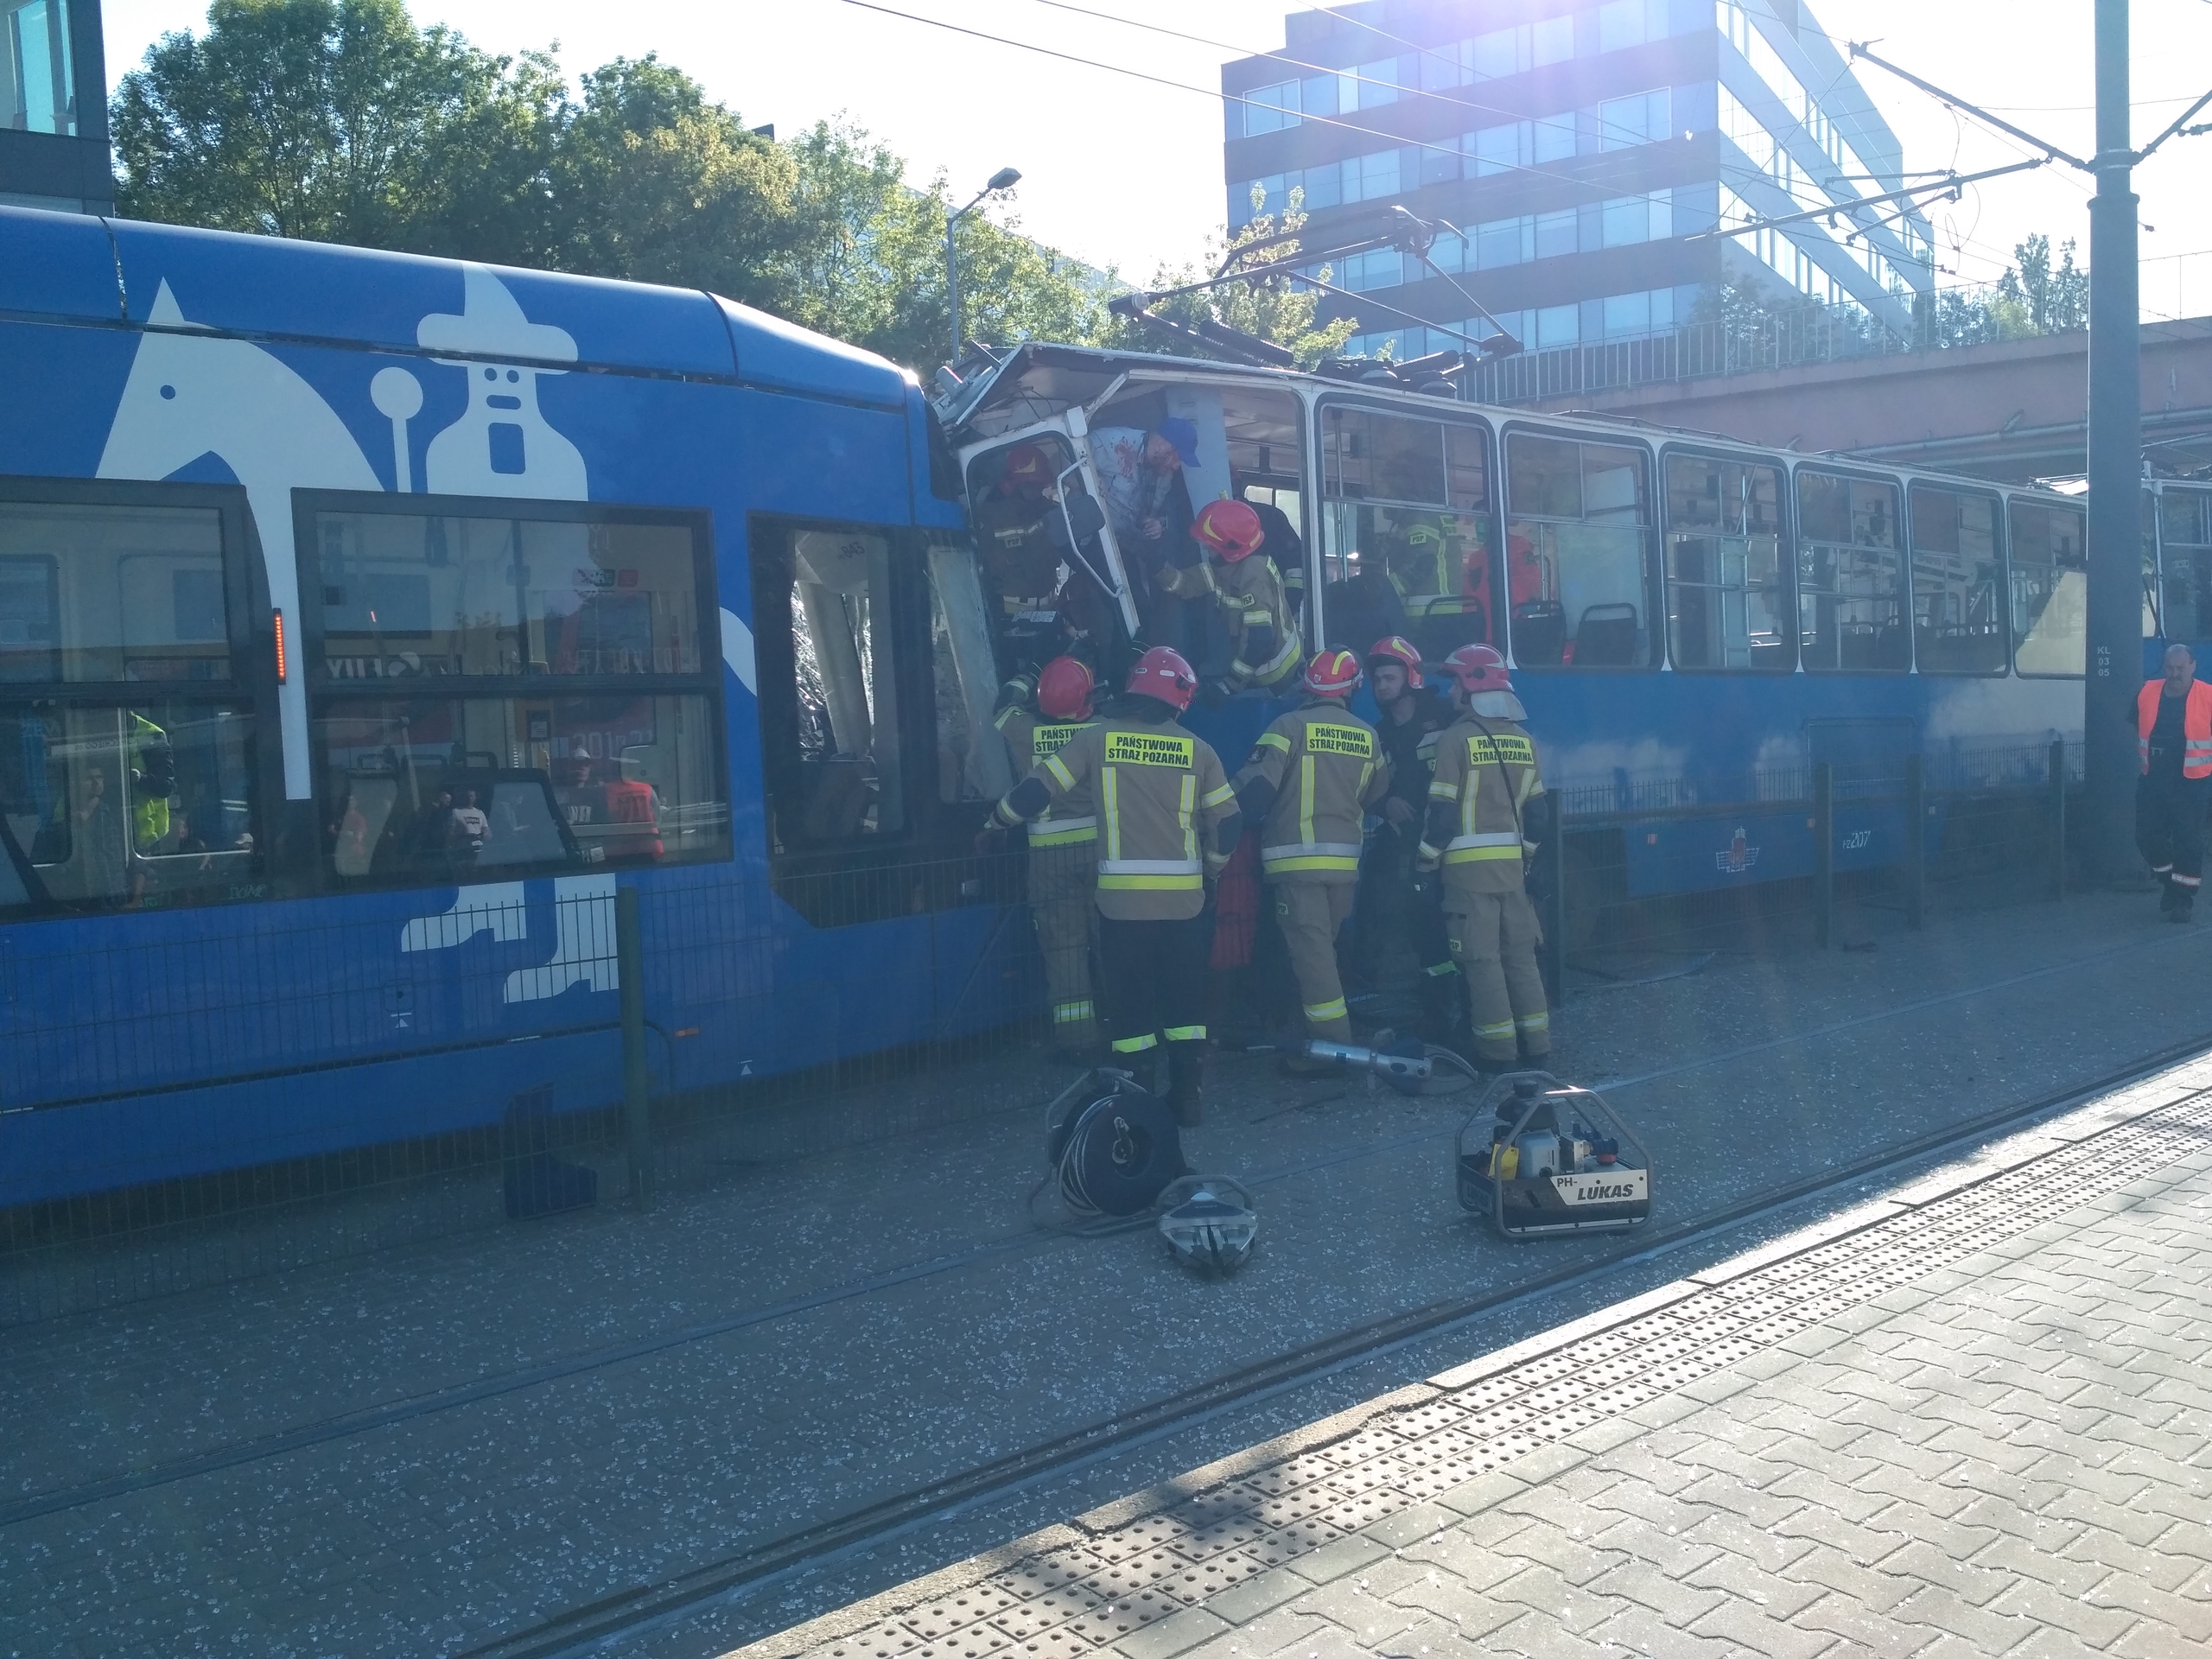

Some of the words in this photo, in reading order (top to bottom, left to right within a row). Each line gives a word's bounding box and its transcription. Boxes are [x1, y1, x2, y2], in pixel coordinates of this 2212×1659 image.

[1041, 728, 1084, 740] PAŃSTW
[1316, 727, 1366, 742] PAŃSTWOWA
[1116, 735, 1183, 752] PAŃSTWOWA
[1108, 748, 1141, 760] STRAŻ
[1142, 751, 1189, 766] POŻARNA
[1577, 1184, 1634, 1200] LUKAS
